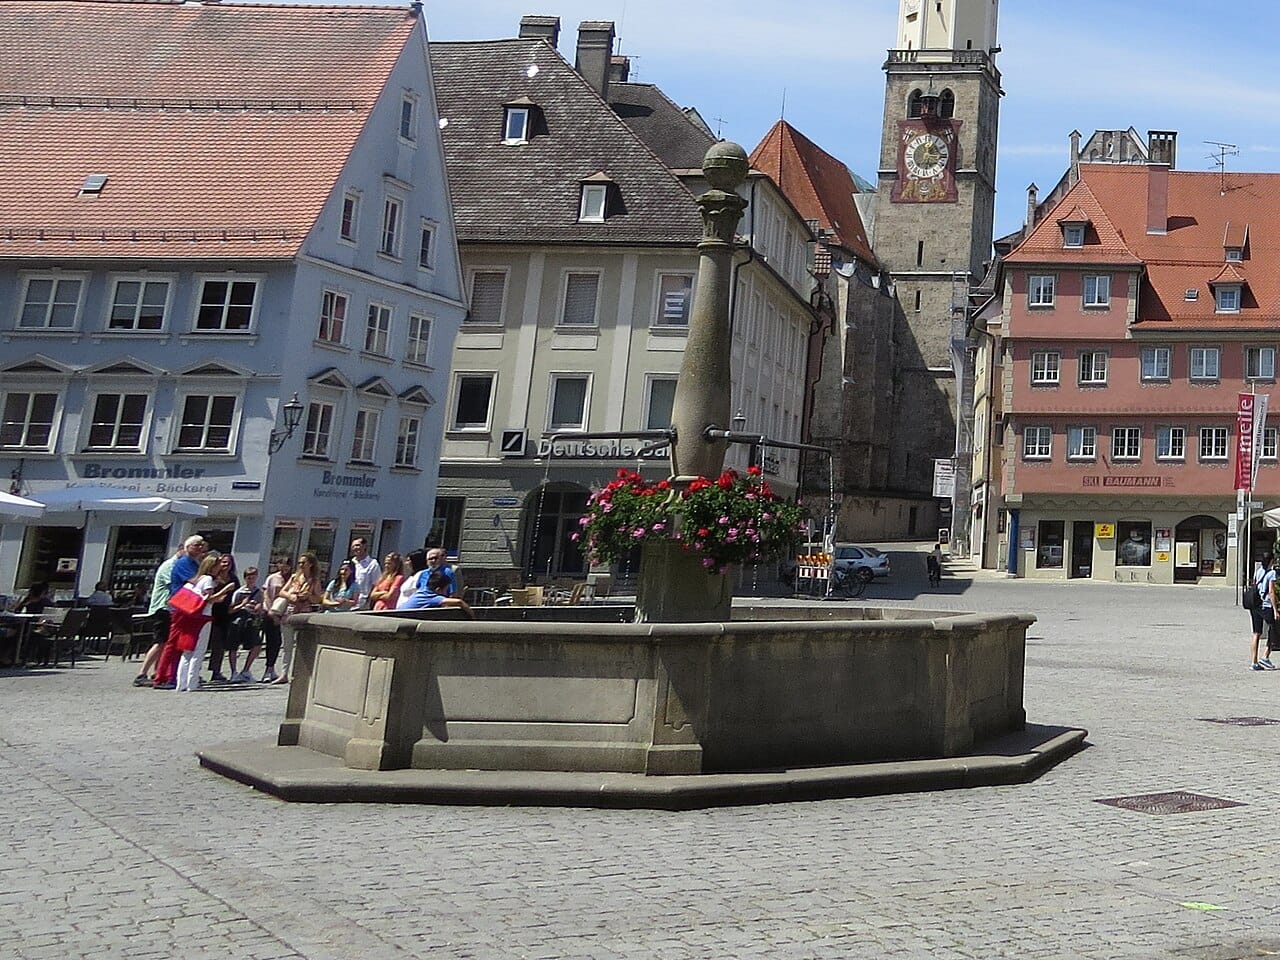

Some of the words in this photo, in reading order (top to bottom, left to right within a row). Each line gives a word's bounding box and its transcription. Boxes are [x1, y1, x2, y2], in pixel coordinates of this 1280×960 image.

[537, 440, 634, 457] Deutsche
[84, 463, 206, 479] Brommler
[322, 470, 377, 488] Brommler
[1104, 476, 1160, 486] BAUMANN
